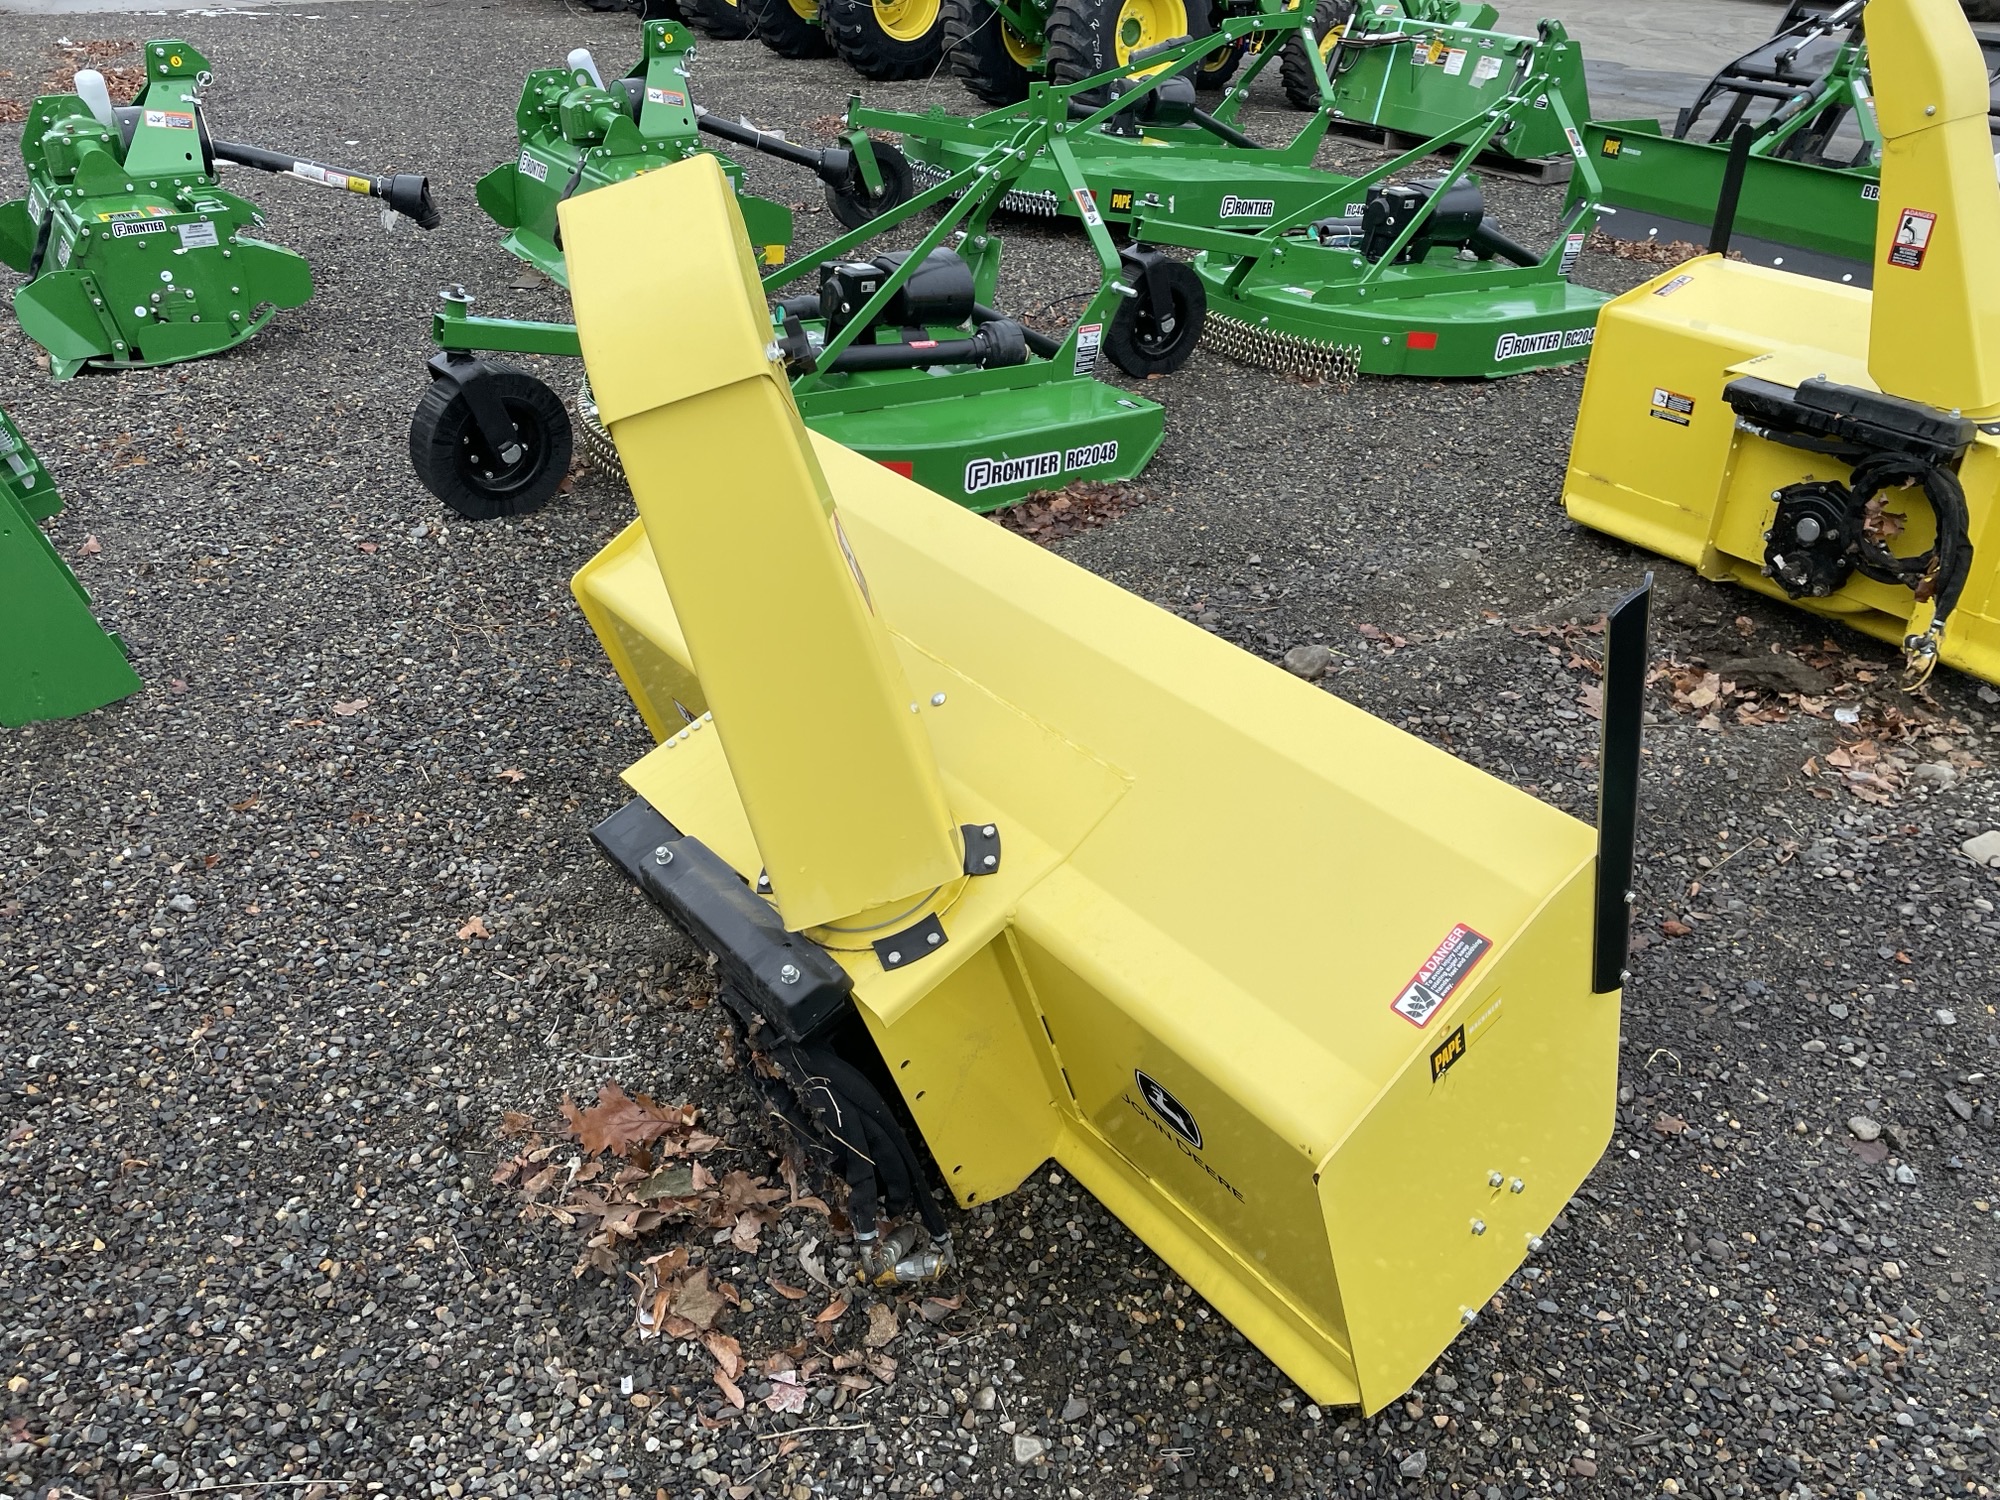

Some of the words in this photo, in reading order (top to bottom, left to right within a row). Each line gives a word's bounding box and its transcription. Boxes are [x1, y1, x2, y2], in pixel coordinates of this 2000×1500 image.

[1222, 197, 1273, 216] FRONTIER
[1864, 186, 1881, 199] BB
[113, 222, 165, 236] FRONTIER
[1498, 333, 1560, 359] FRONTIER
[968, 454, 1059, 491] FRONTIER
[1066, 443, 1117, 470] RC2048
[1425, 927, 1466, 971] DANGER
[1425, 977, 1434, 987] To
[1430, 964, 1444, 981] avoid
[1441, 951, 1455, 968] injury
[1453, 940, 1465, 953] from
[1430, 970, 1448, 990] rotating
[1457, 944, 1470, 958] keep
[1448, 966, 1459, 977] feet
[1456, 958, 1467, 969] and
[1464, 938, 1483, 959] clothing
[1122, 1094, 1172, 1141] JOHN
[1176, 1138, 1245, 1204] DEERE
